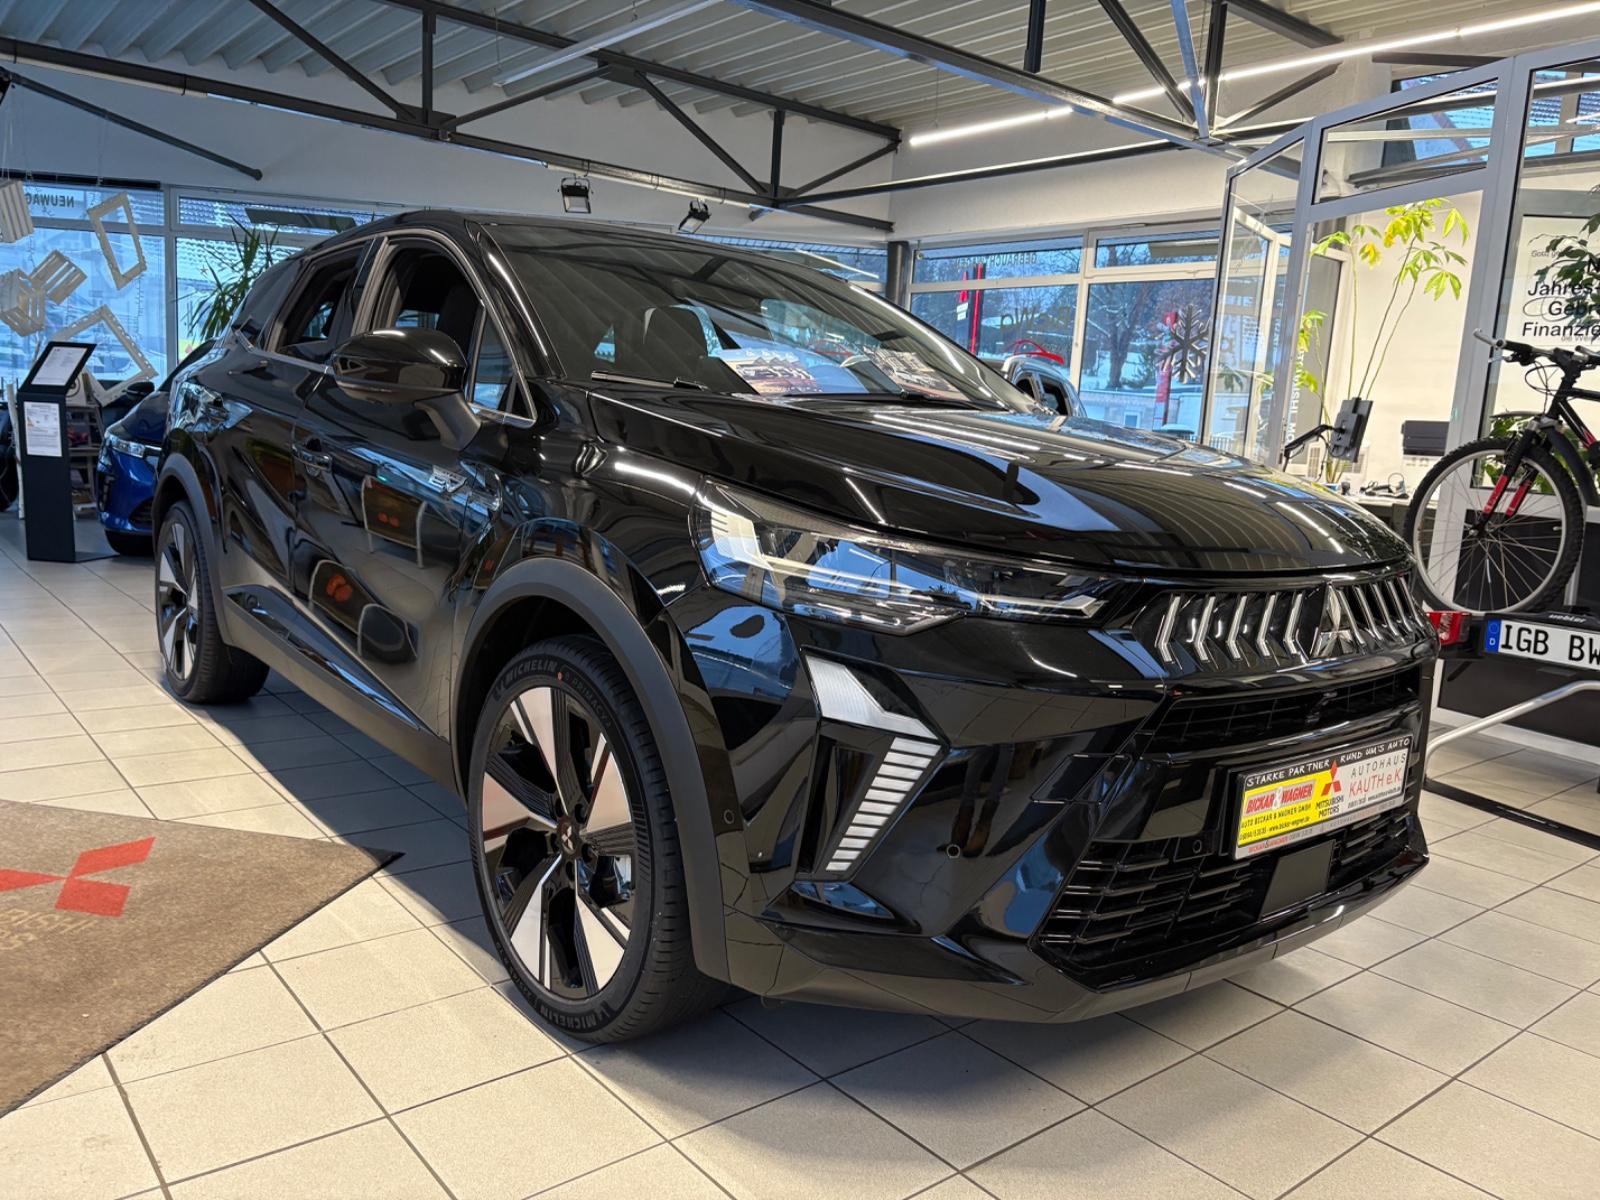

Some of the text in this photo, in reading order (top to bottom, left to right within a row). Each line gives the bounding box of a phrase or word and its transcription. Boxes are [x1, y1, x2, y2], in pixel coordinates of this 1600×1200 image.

[1489, 637, 1496, 646] D
[1501, 624, 1549, 655] IGB
[505, 660, 558, 686] MICHELIN
[1246, 771, 1285, 787] STARKE
[1288, 759, 1331, 777] PARTNER
[1340, 751, 1363, 763] RUND
[1387, 737, 1410, 750] AUTO
[1350, 752, 1407, 779] AUTOHAUS
[1280, 783, 1313, 804] WAGNER
[1348, 772, 1385, 798] KAUTH
[1318, 804, 1340, 819] MOTORS
[540, 1005, 597, 1029] MICHELIN
